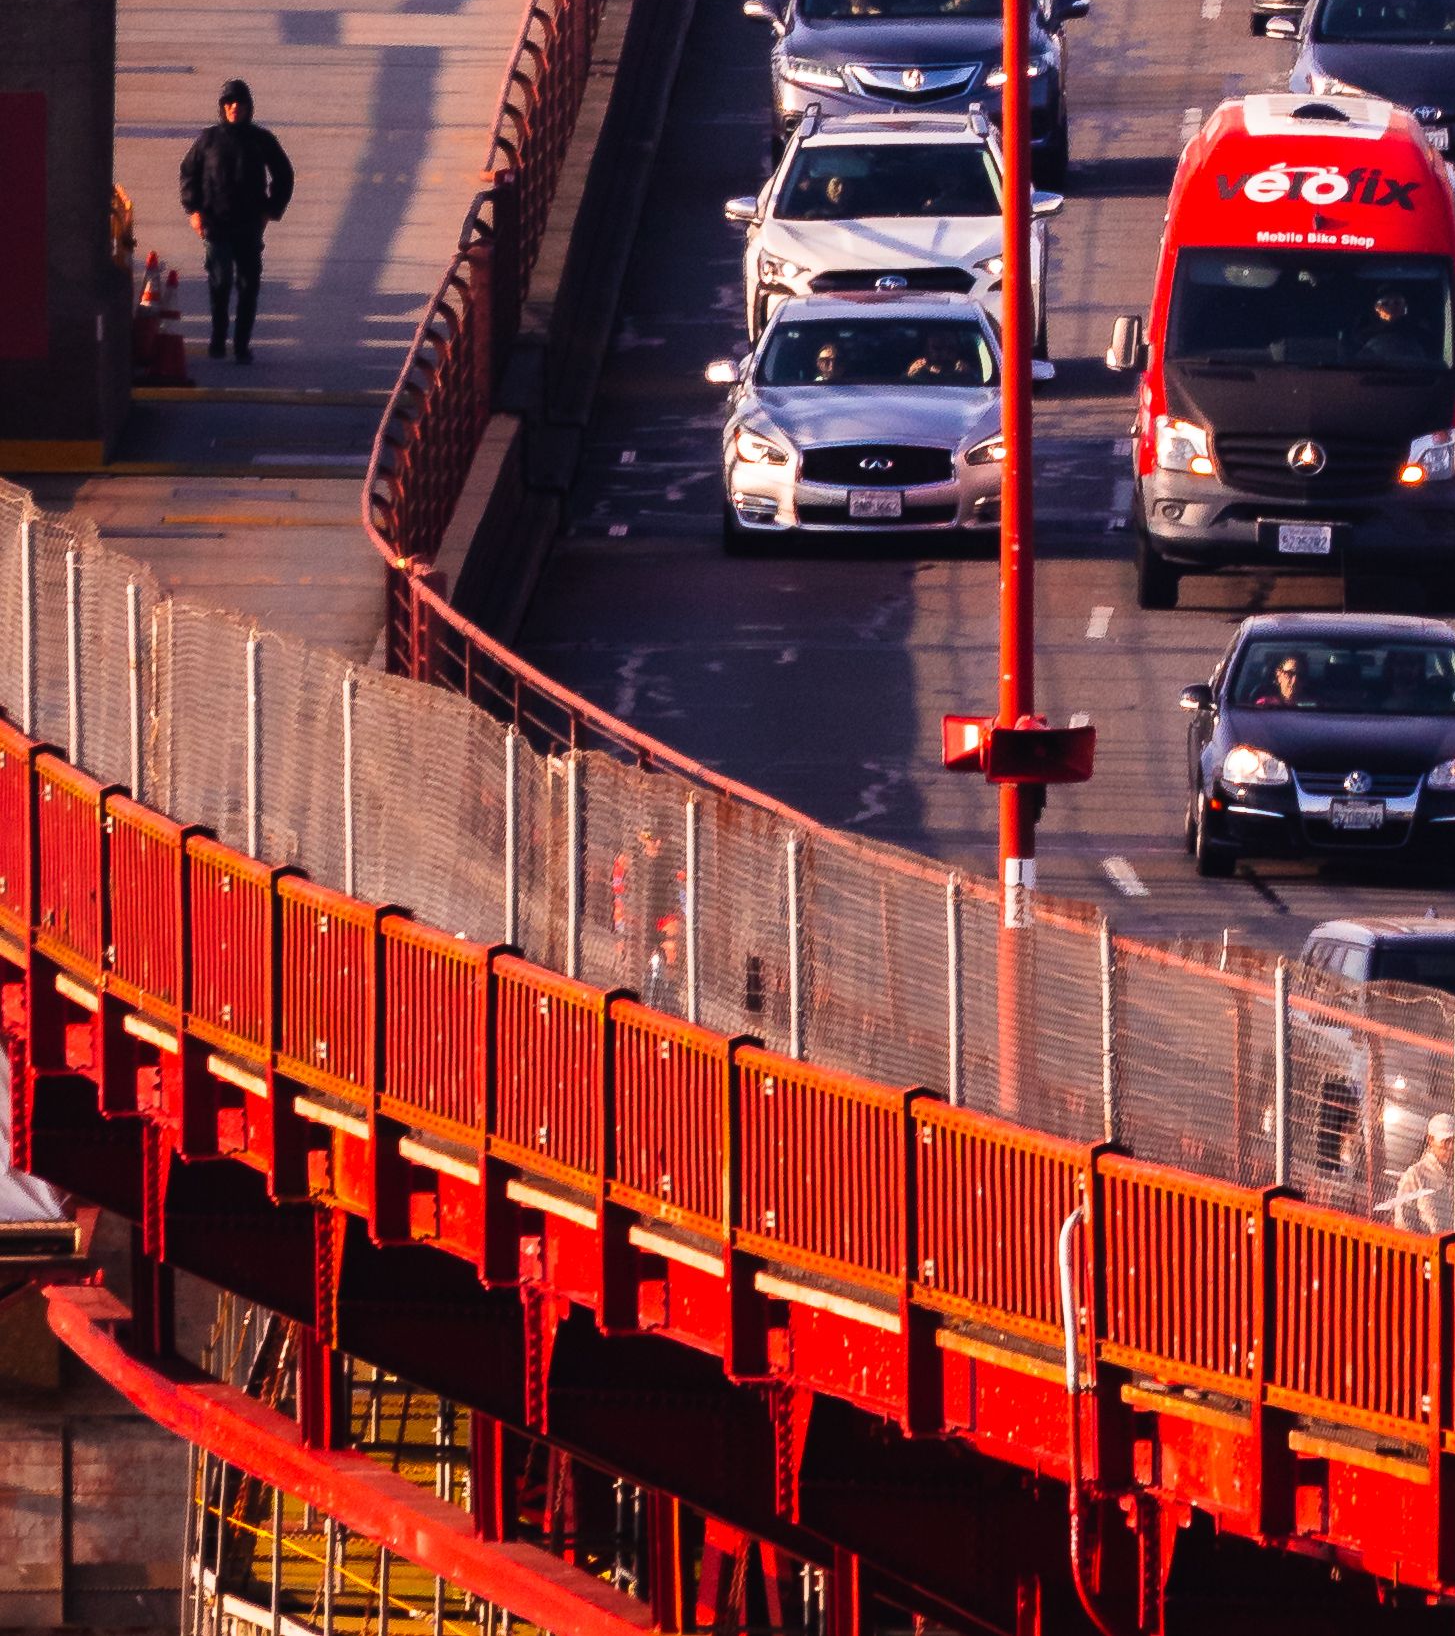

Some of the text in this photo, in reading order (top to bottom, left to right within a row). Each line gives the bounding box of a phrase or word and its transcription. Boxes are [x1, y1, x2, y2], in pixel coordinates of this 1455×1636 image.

[1257, 231, 1376, 250] Mobile Bike Shop
